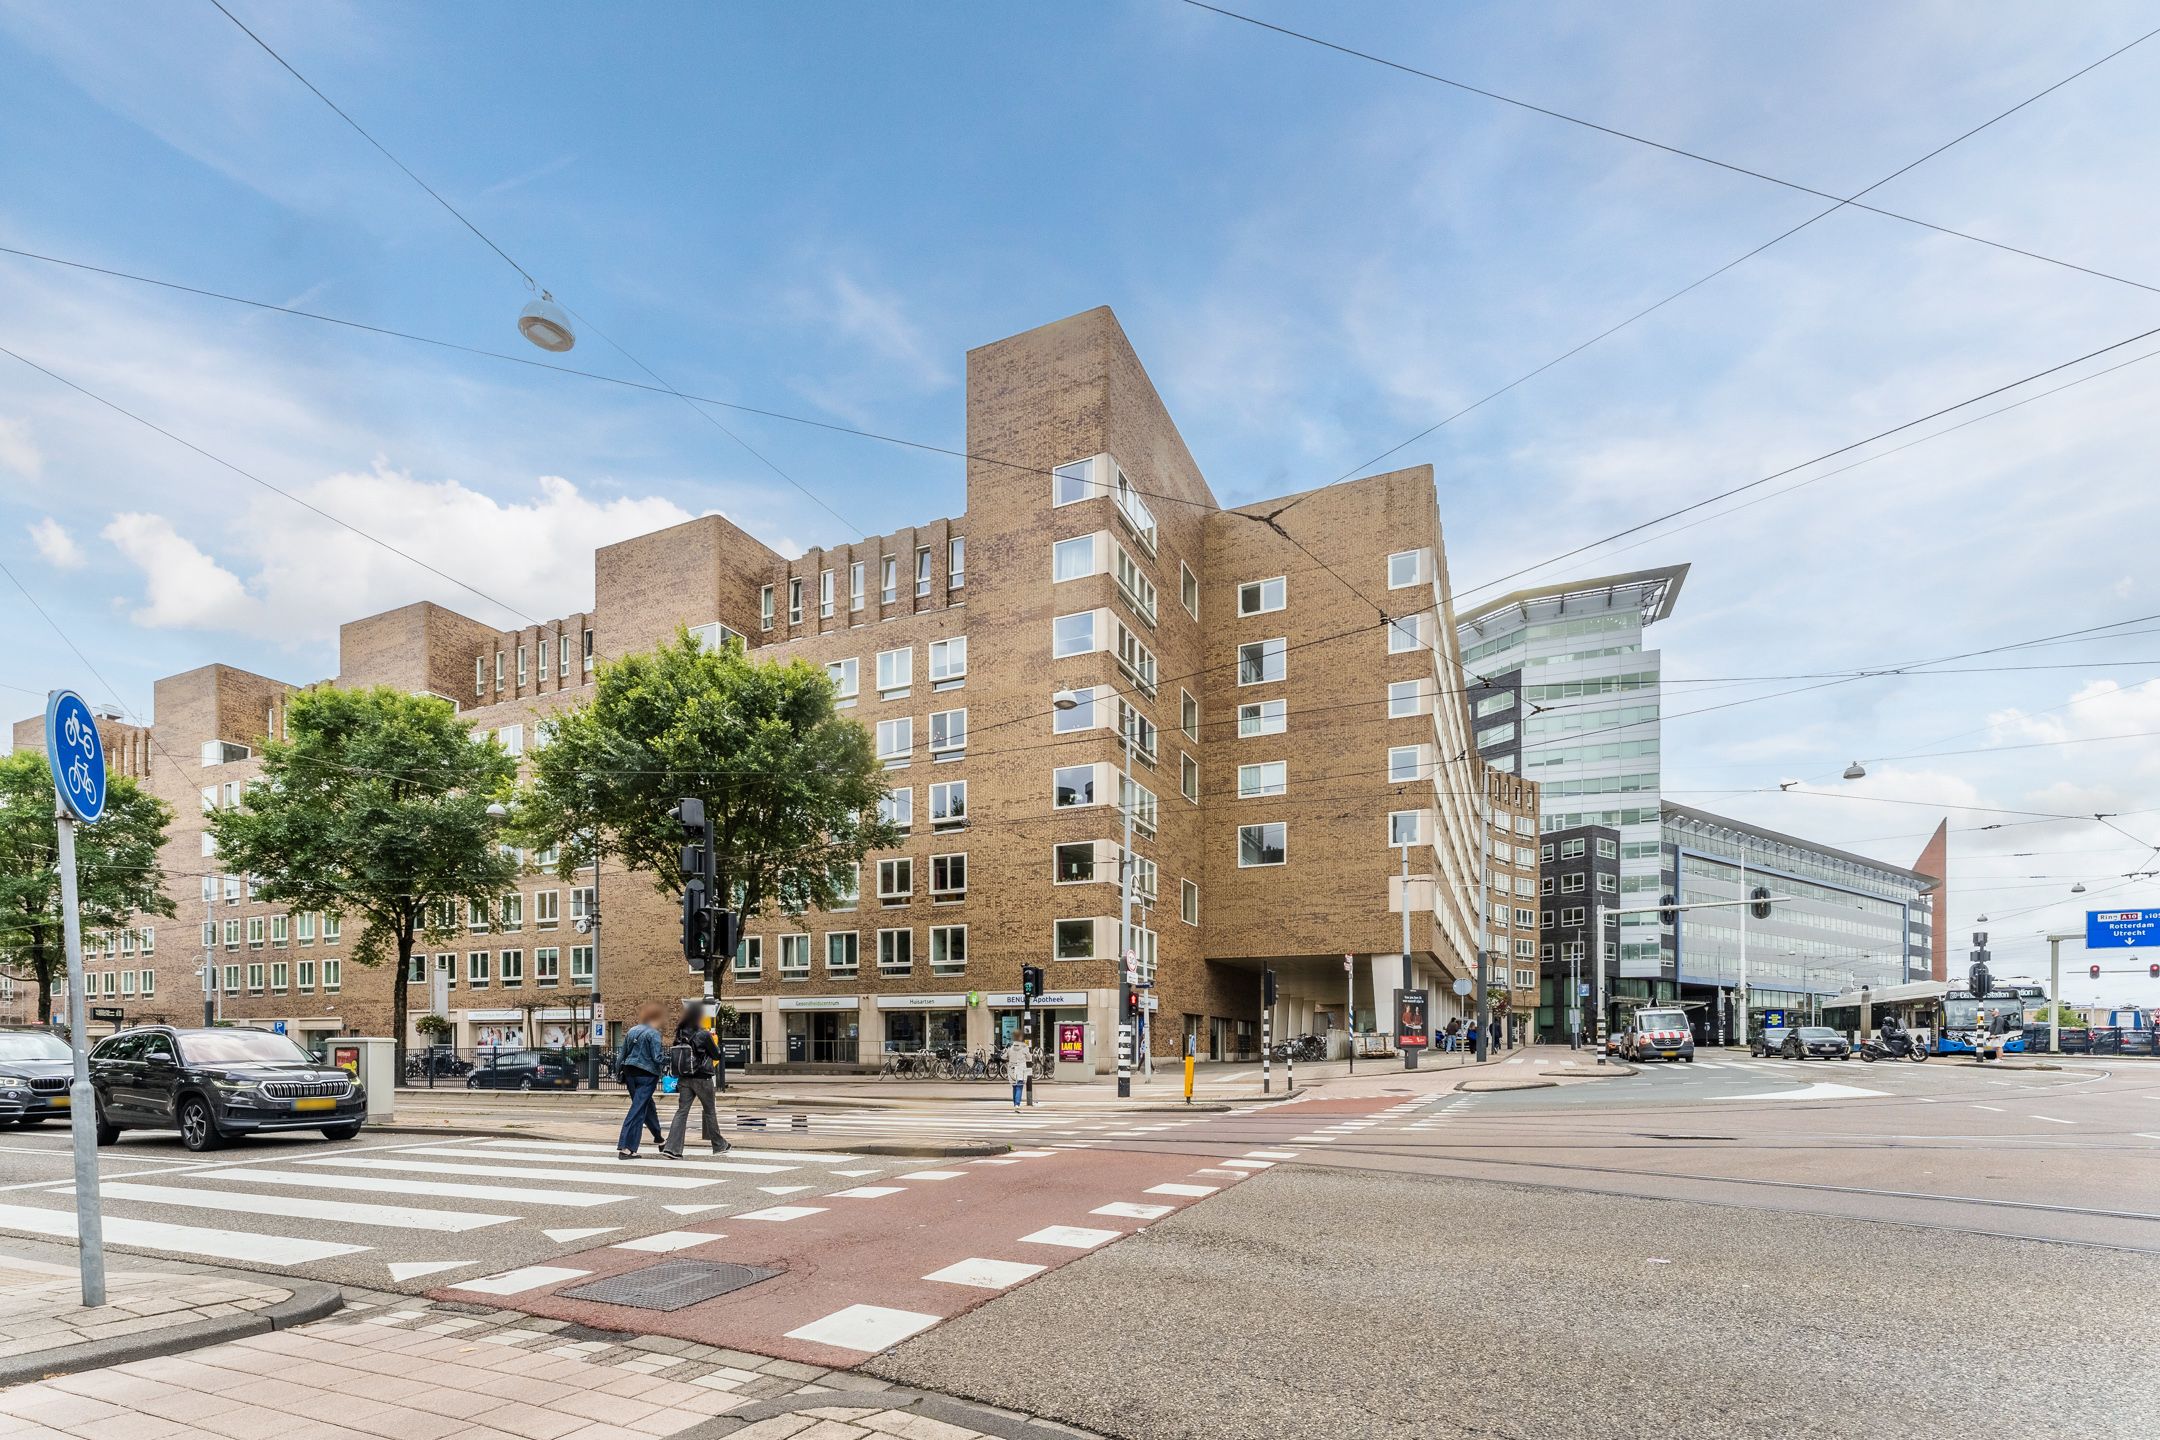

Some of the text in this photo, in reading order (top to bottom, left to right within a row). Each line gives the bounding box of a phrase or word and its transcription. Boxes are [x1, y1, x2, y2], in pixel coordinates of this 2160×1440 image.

[2113, 929, 2146, 937] Utrecht
[1032, 995, 1065, 1004] Apotheek
[1061, 1042, 1082, 1051] LAAT ME
